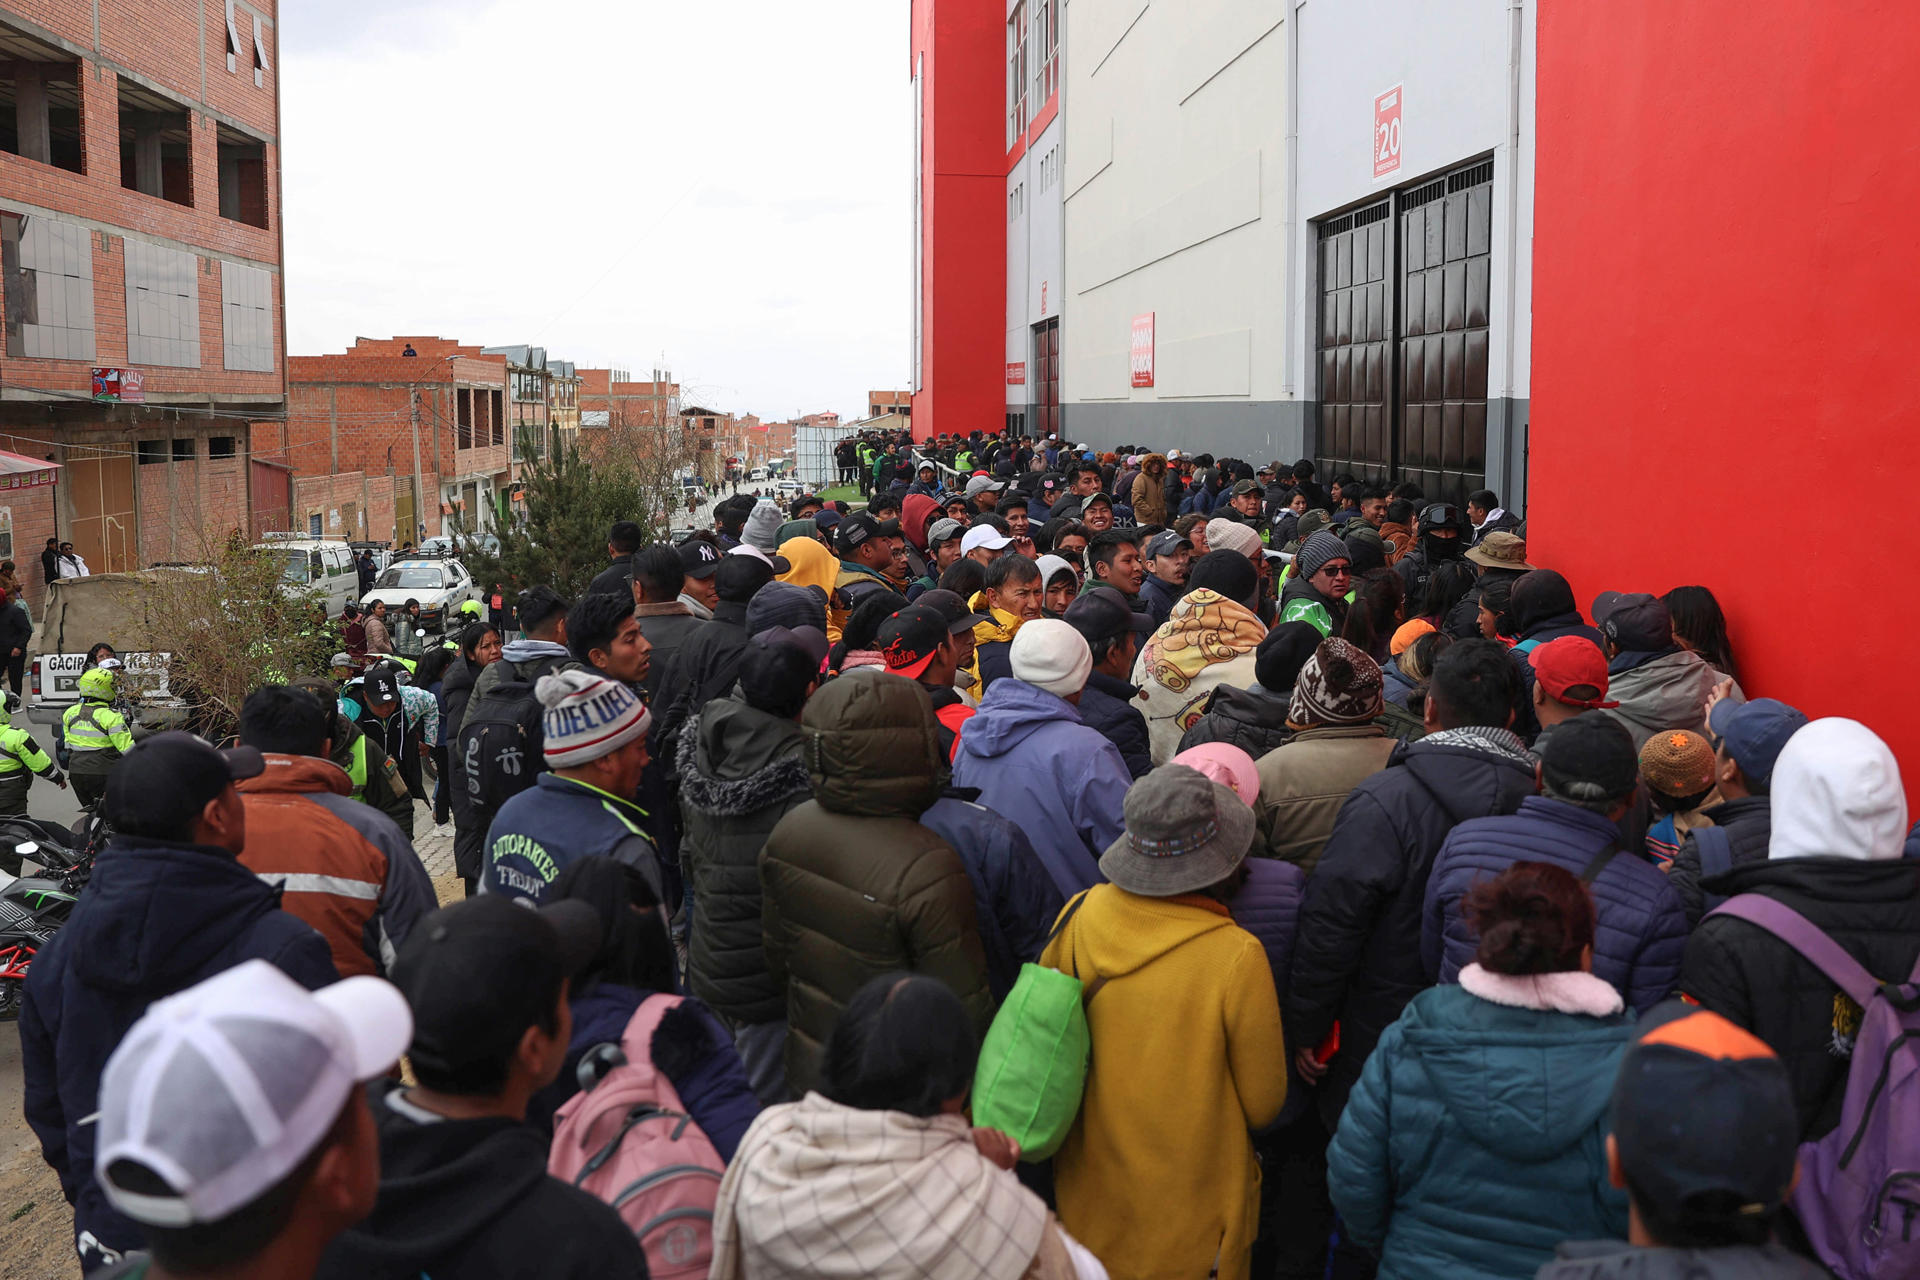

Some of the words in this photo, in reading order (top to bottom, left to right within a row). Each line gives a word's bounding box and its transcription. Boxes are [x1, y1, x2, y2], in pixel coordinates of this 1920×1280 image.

[1380, 117, 1400, 161] 20
[699, 545, 715, 561] NY
[378, 680, 389, 692] LA
